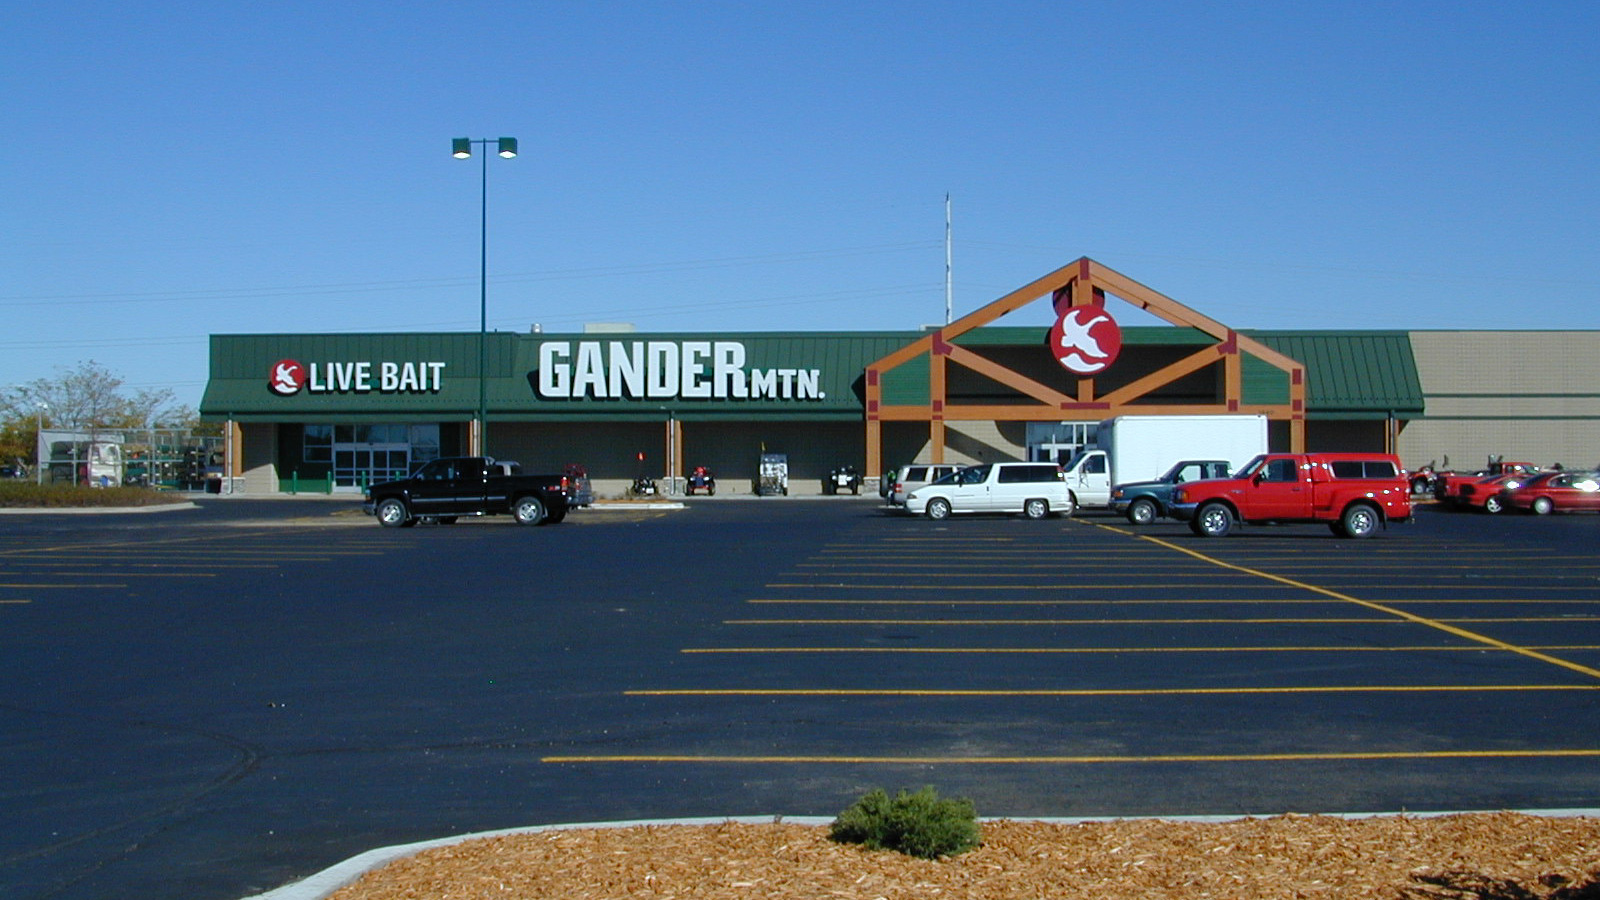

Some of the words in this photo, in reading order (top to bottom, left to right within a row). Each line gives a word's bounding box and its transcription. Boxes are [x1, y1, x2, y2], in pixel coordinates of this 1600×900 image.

[309, 361, 372, 391] LIVE
[381, 361, 446, 391] BAIT
[538, 341, 749, 398] GANDER
[751, 368, 826, 399] MTN.
